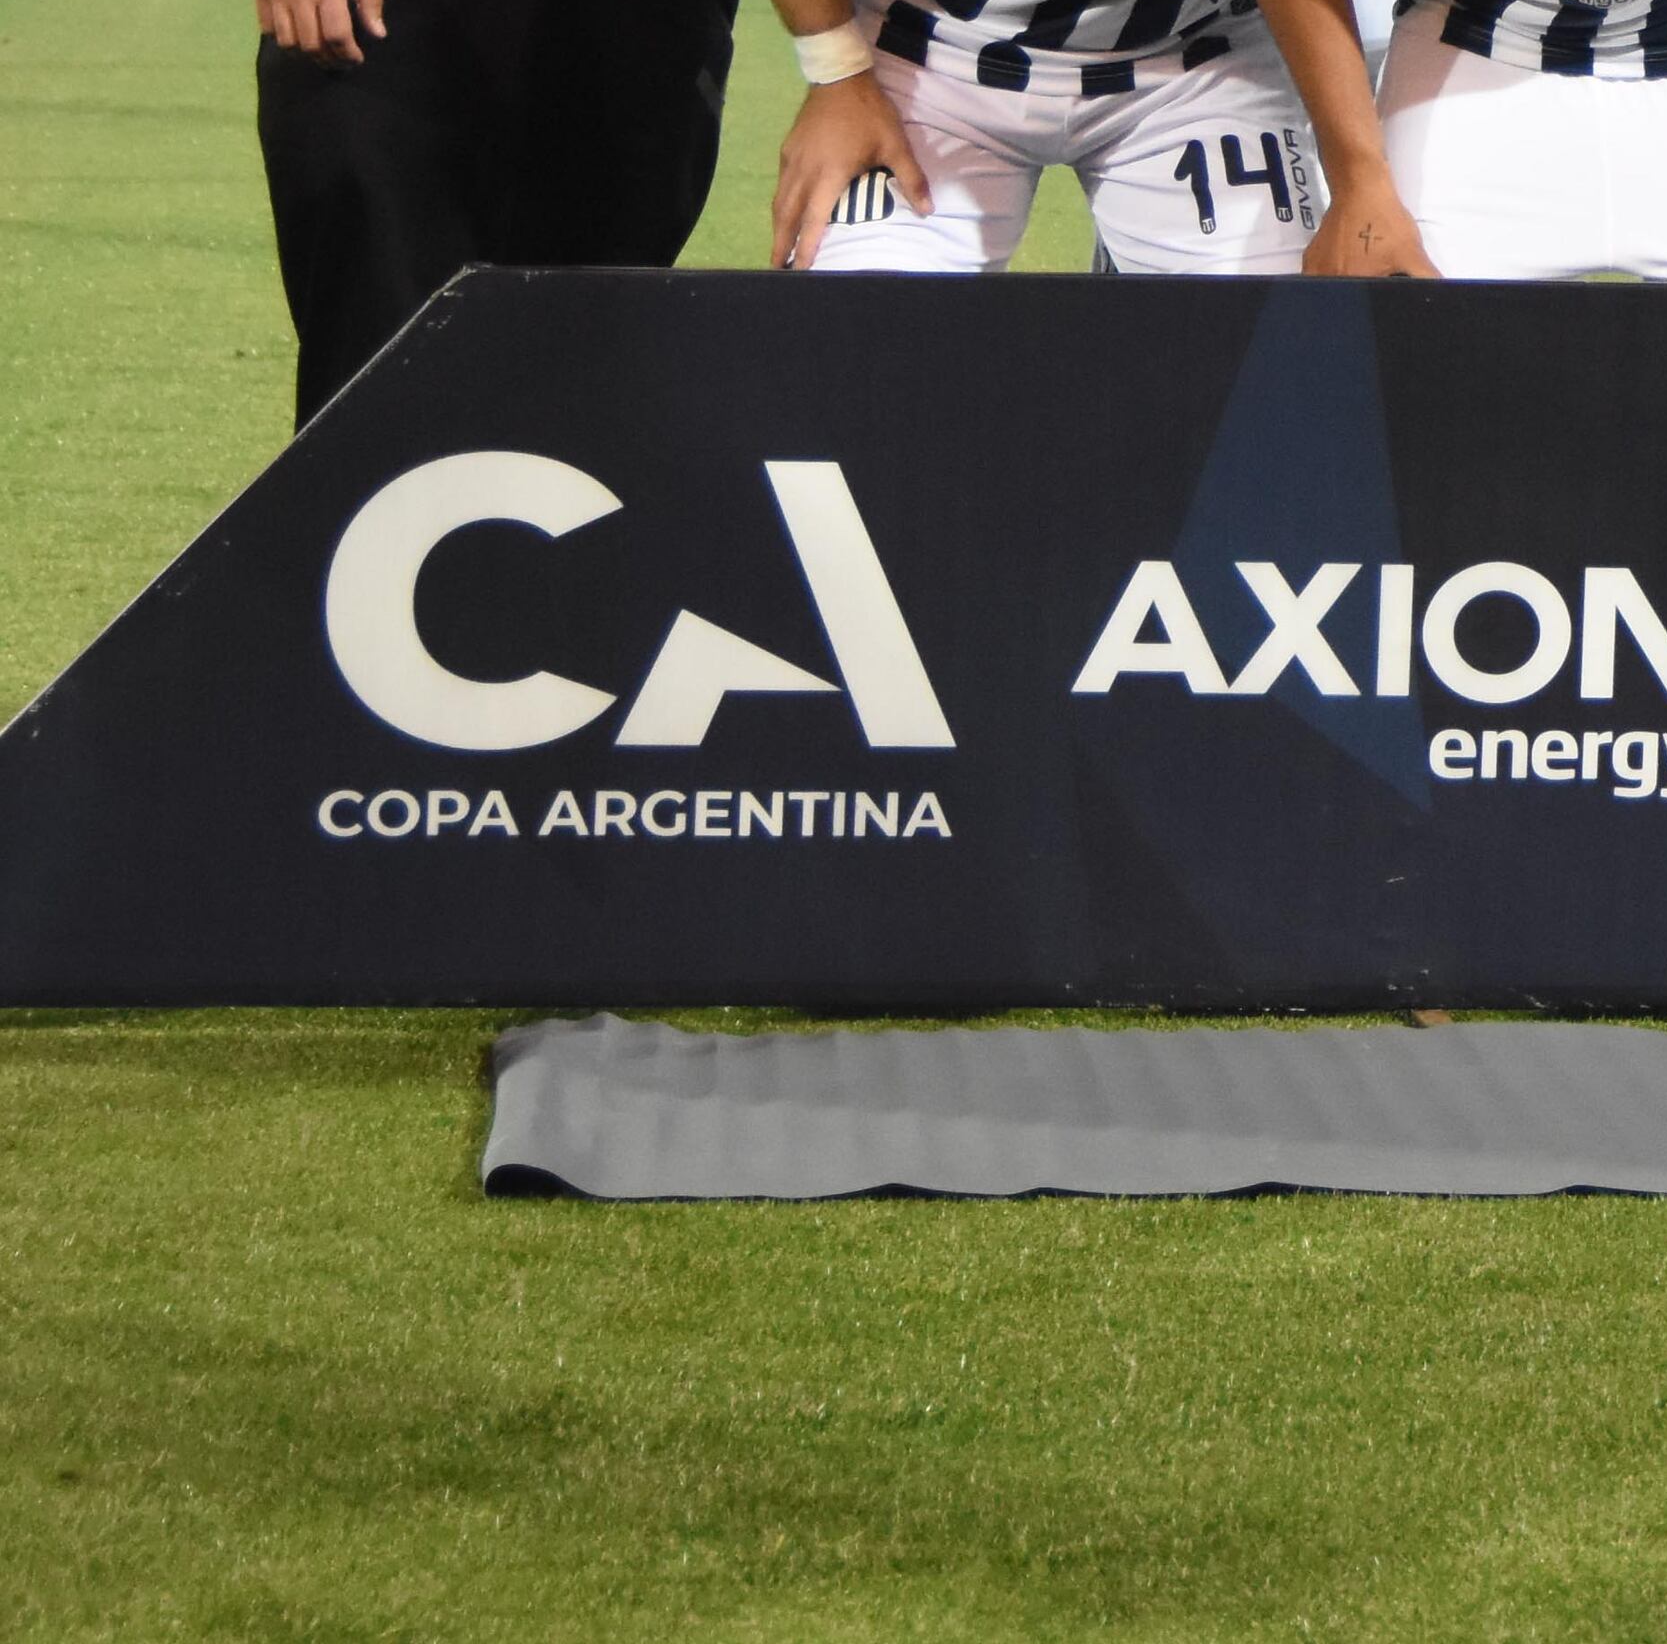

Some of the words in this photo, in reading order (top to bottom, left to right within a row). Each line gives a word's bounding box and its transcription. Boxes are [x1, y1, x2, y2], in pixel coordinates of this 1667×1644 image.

[1174, 132, 1294, 234] 14
[1284, 128, 1316, 231] GIVOVA
[318, 789, 518, 838] COPA
[540, 789, 952, 839] ARGENTINA
